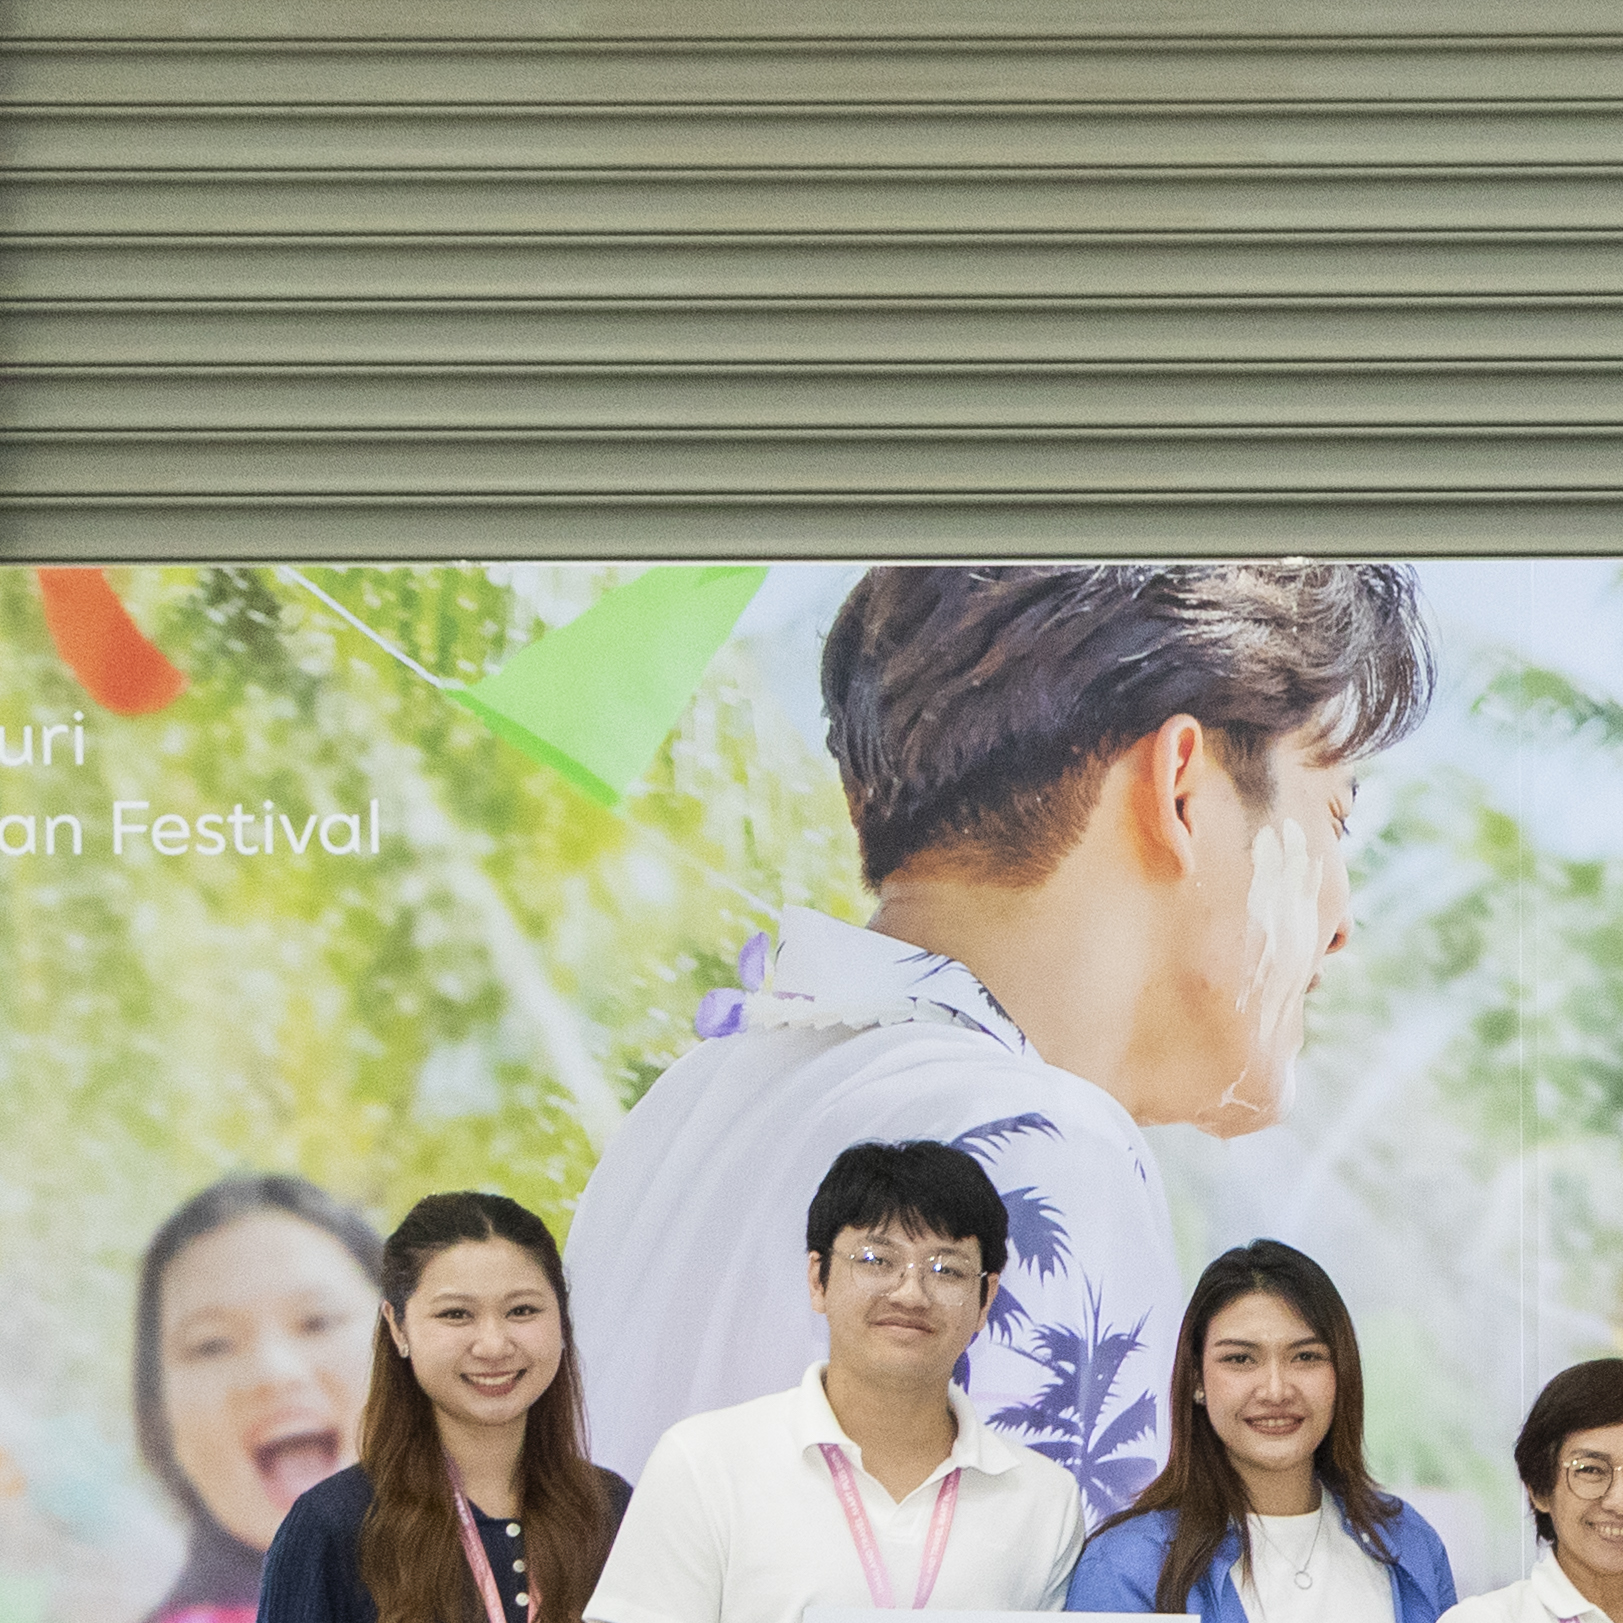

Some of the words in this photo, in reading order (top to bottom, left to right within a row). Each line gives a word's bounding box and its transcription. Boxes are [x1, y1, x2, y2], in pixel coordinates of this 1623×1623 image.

[0, 711, 84, 767] uri
[0, 814, 83, 857] an
[113, 796, 380, 857] Festival
